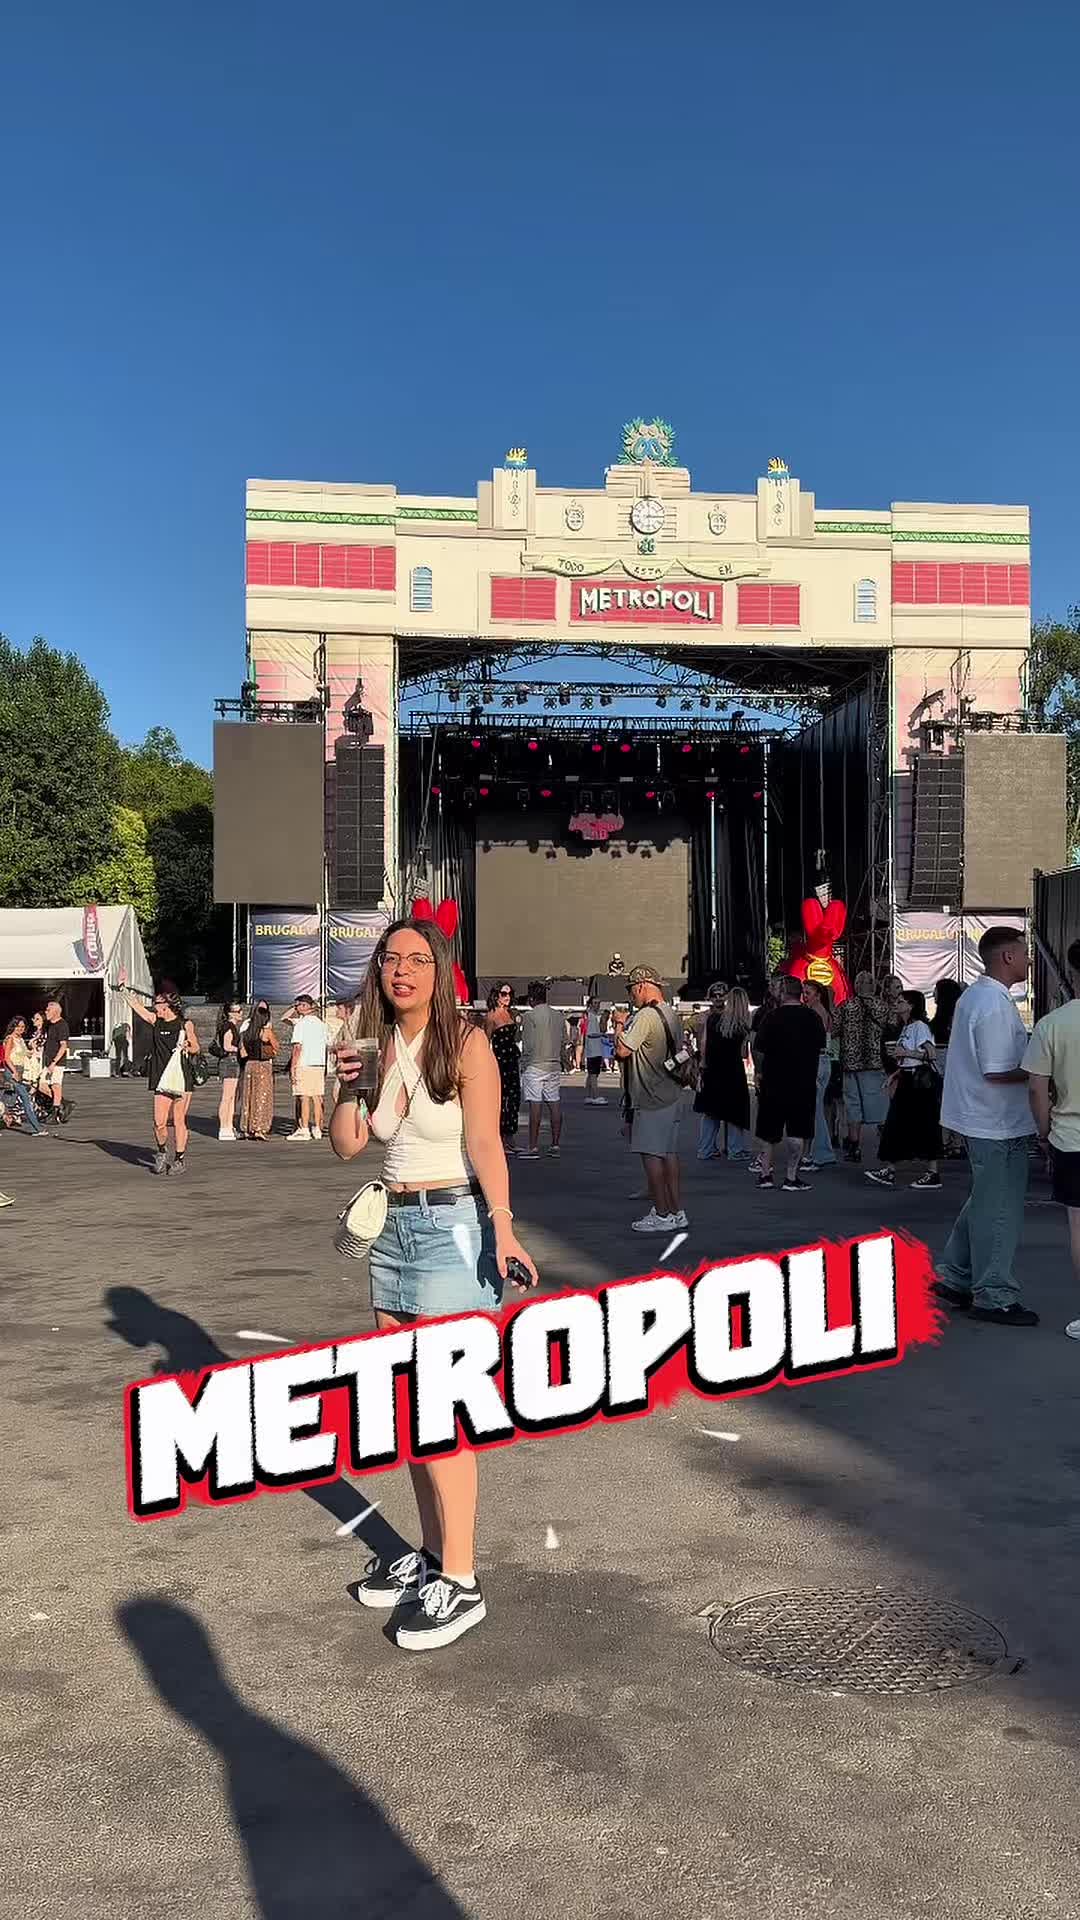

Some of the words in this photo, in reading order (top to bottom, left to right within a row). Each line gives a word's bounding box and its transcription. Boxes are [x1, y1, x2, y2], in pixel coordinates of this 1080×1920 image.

[557, 558, 584, 573] TODO
[718, 563, 733, 576] EN
[255, 924, 305, 937] BRUGAL
